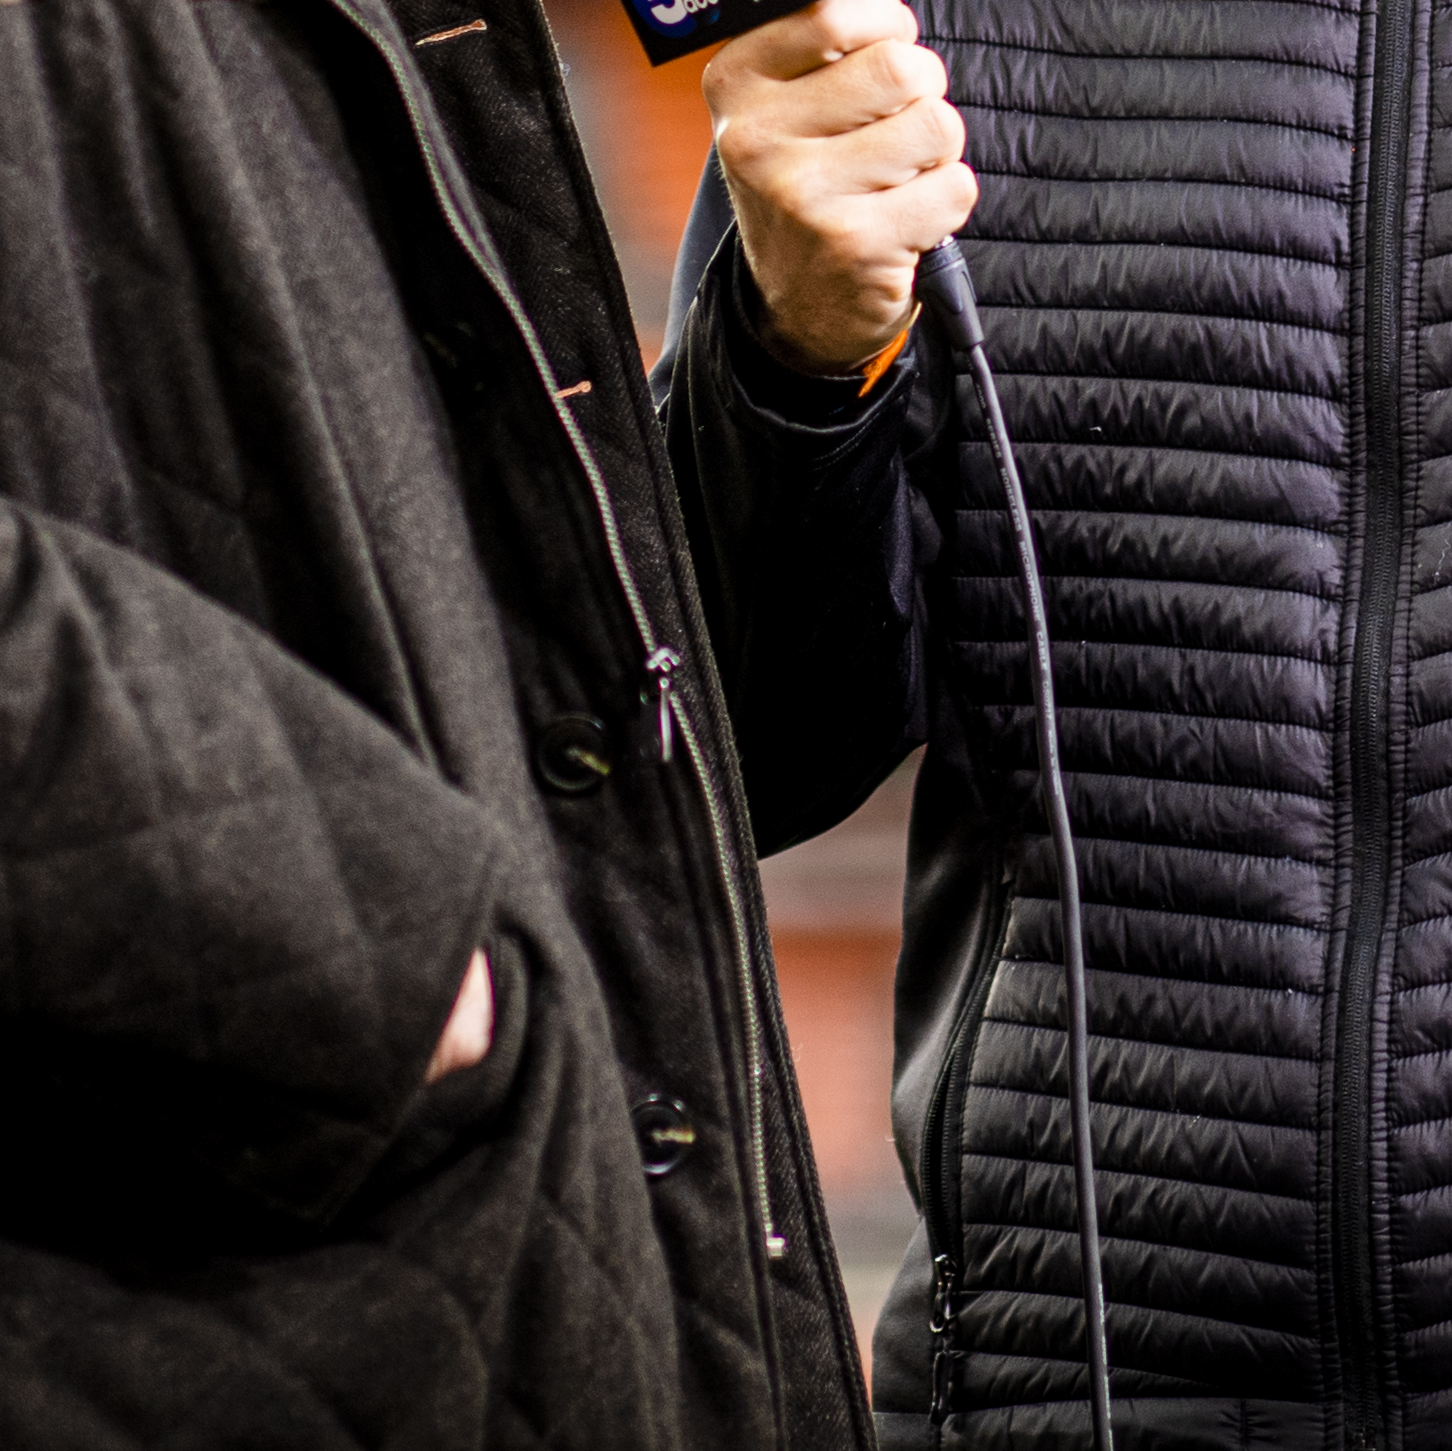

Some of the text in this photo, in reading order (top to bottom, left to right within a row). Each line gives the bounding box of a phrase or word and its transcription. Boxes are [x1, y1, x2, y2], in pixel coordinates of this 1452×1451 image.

[1000, 467, 1023, 532] NOISELESS
[1019, 541, 1042, 622] MICROPHONE
[1036, 631, 1050, 671] CABLE
